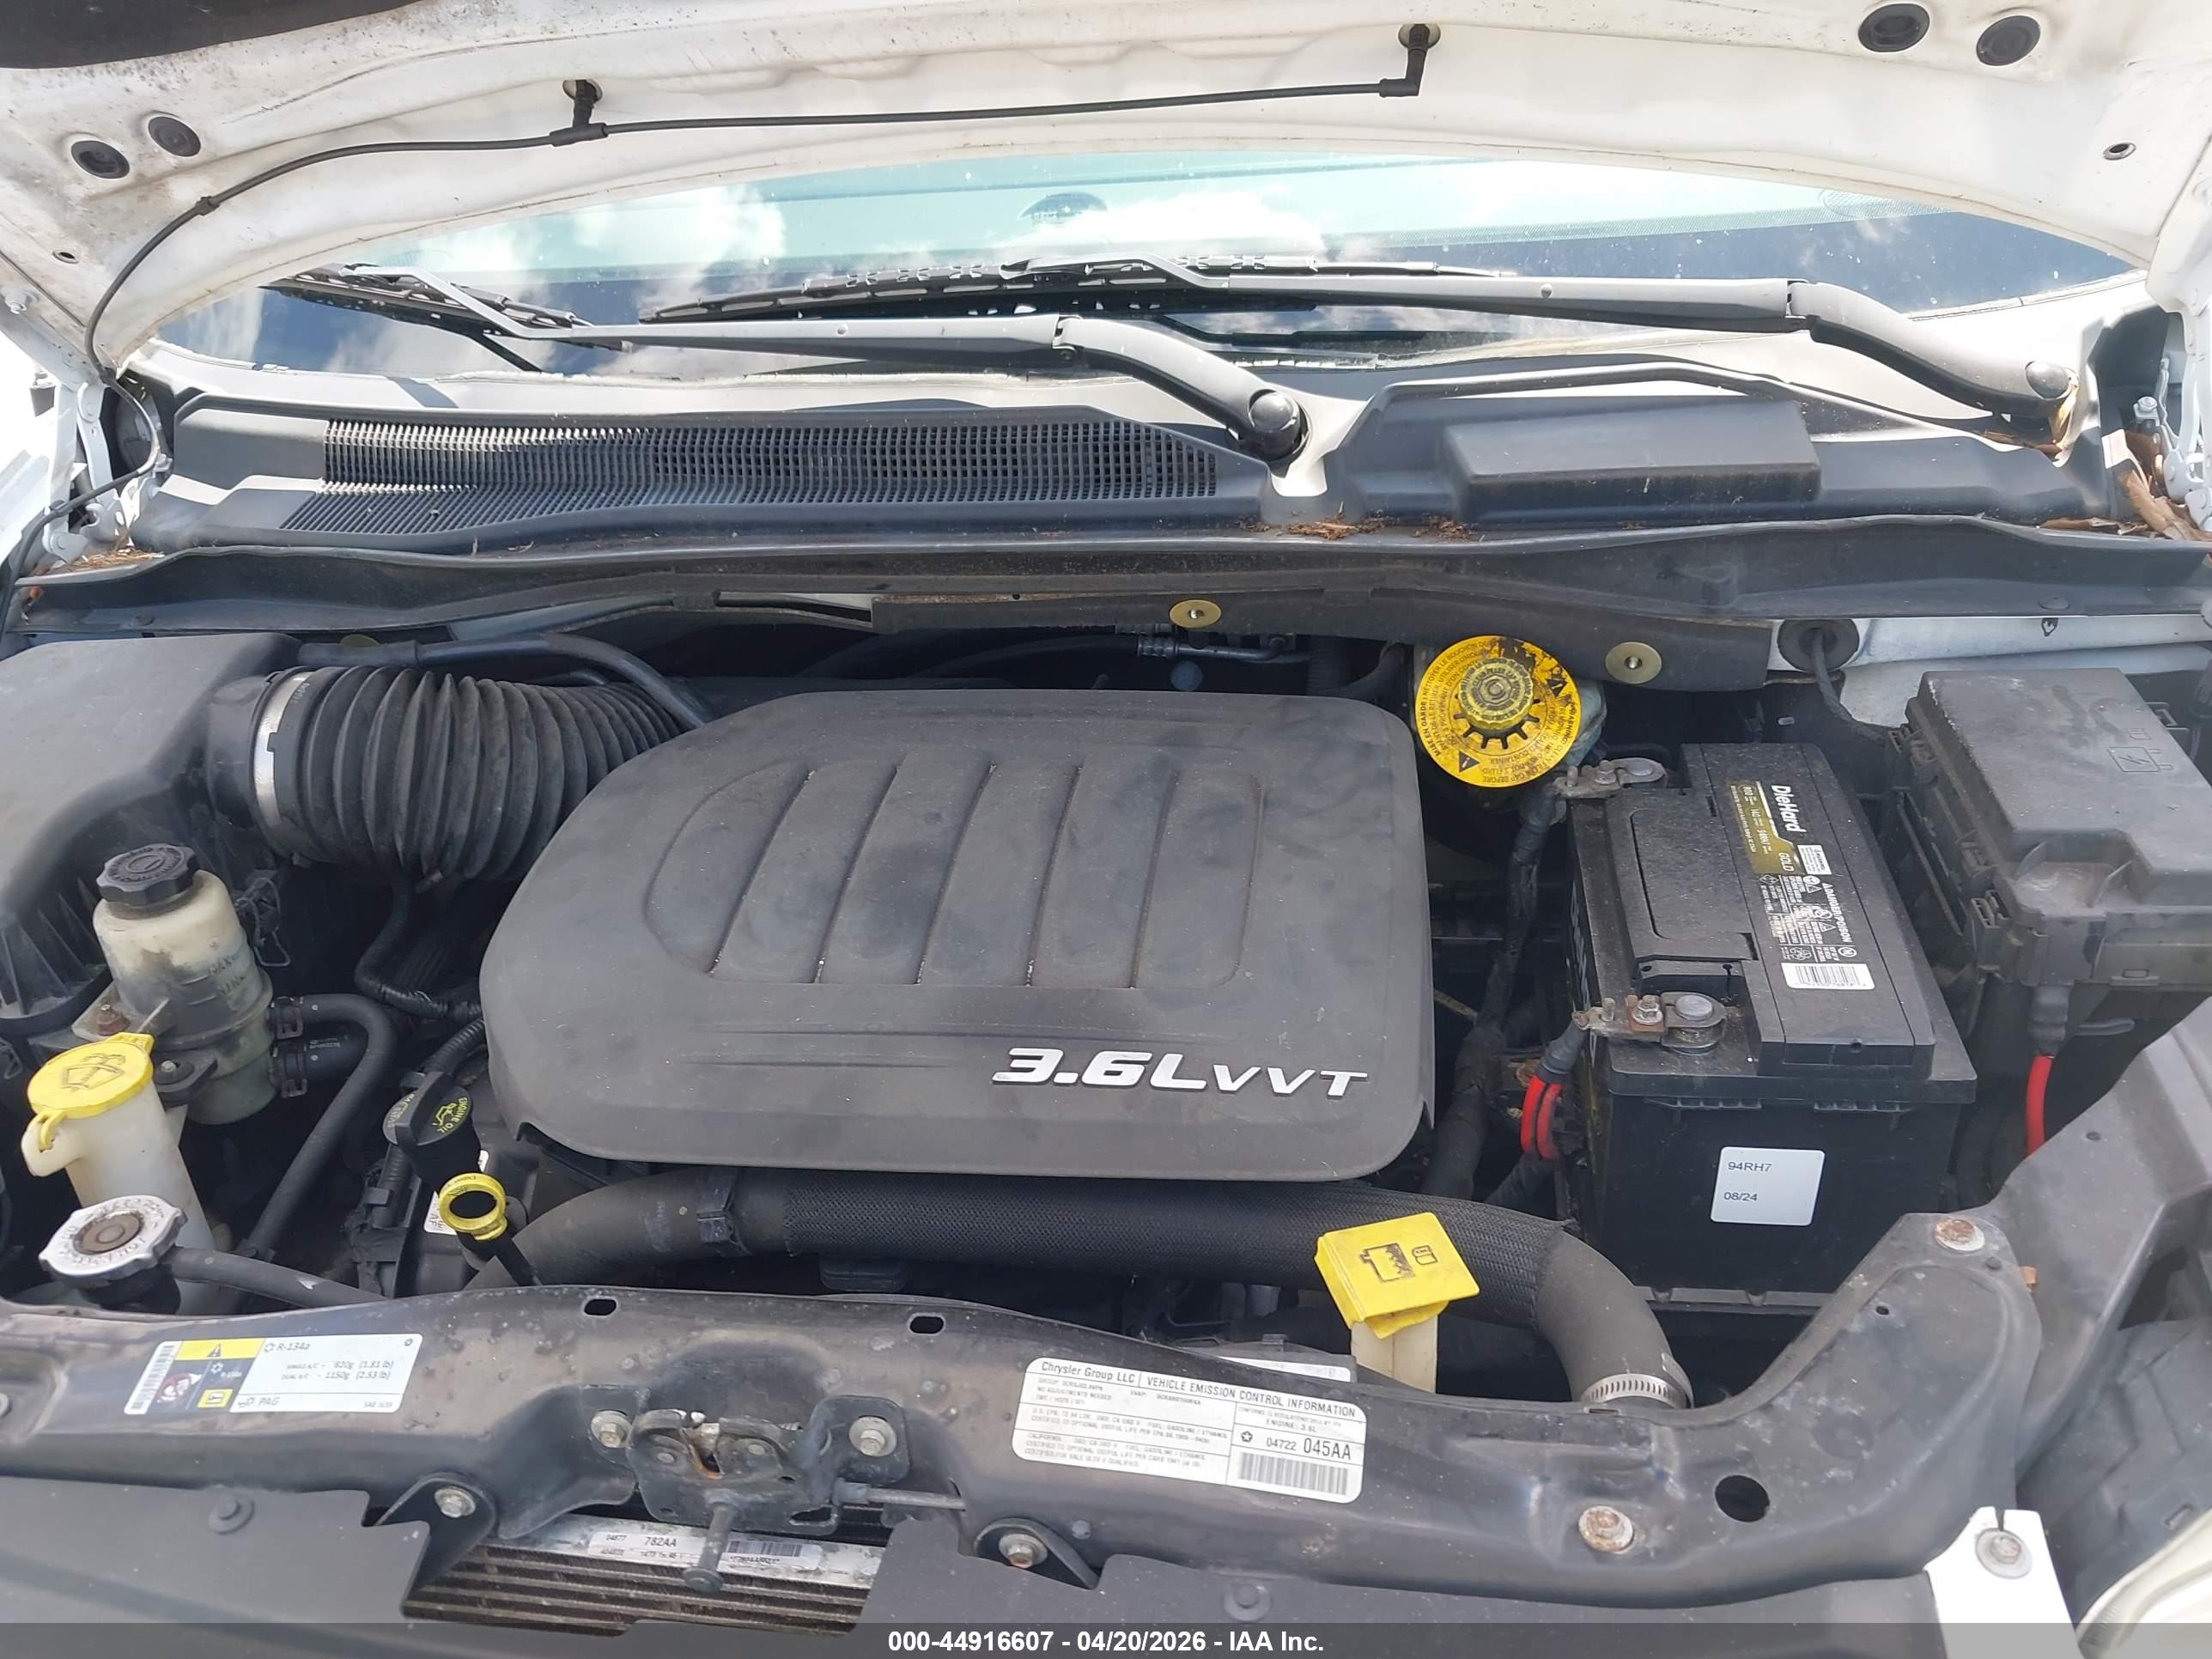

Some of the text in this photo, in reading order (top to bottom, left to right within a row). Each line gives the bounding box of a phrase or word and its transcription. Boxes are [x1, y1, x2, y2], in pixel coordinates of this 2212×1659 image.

[1421, 665, 1442, 696] NETTOYER
[1422, 727, 1431, 738] EN
[1426, 738, 1441, 756] MISE
[1771, 785, 1807, 833] DieHard
[1778, 852, 1794, 872] GOLD
[1212, 1063, 1369, 1097] VVT
[436, 1097, 467, 1133] ENGINE OIL
[1728, 1162, 1772, 1172] 94RH7
[1723, 1192, 1758, 1201] 08/24
[1042, 1362, 1135, 1383] Chrysler Group LLC
[258, 1397, 280, 1407] PAG
[1147, 1376, 1187, 1391] VEHICLE
[1190, 1382, 1237, 1398] EMISSION
[1239, 1390, 1284, 1407] CONTROL
[1288, 1399, 1356, 1418] INFORMATION
[1266, 1437, 1351, 1461] 04722 045AA
[646, 1536, 677, 1547] 782AA
